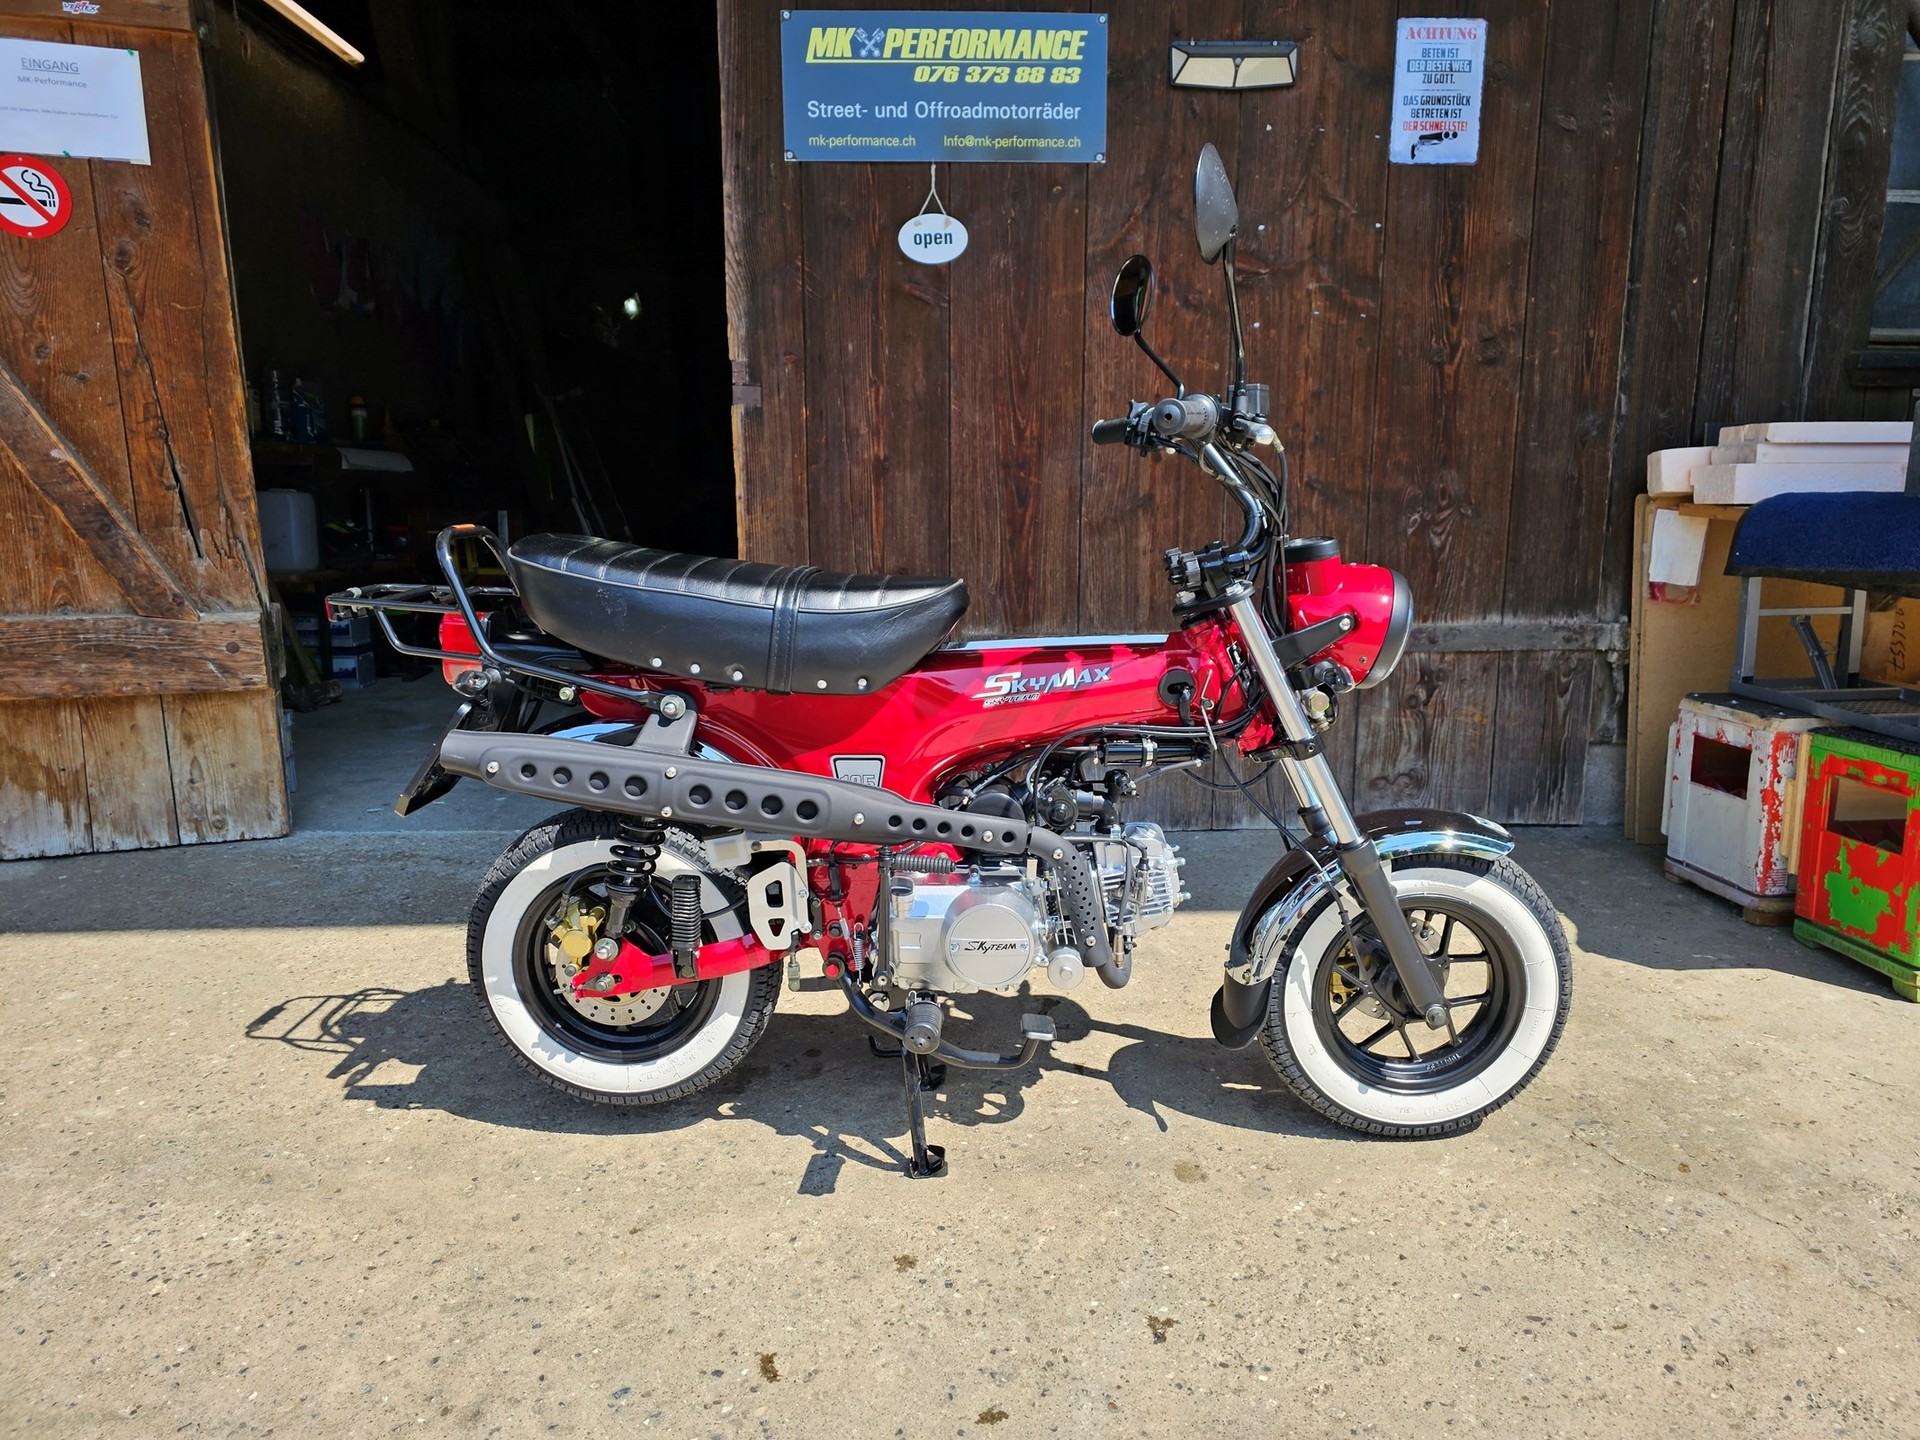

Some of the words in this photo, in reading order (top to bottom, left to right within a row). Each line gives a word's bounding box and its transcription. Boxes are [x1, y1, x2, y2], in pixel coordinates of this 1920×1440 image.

[1405, 26, 1478, 40] ACHTUNG
[806, 27, 856, 63] MK
[882, 28, 1088, 60] PERFORMANCE
[1421, 47, 1446, 59] BETEN
[1447, 47, 1460, 58] IST
[21, 57, 79, 73] EINGANG
[1409, 60, 1426, 72] DER
[1426, 60, 1452, 72] BESTE
[1452, 60, 1470, 72] WEG
[17, 75, 87, 88] MK-Performance
[913, 65, 960, 83] 076
[964, 65, 1011, 84] 373
[1013, 66, 1046, 84] 88
[1049, 66, 1082, 84] 83
[1422, 73, 1433, 84] ZU
[1434, 73, 1456, 84] GOTT.
[1403, 95, 1419, 107] DAS
[1420, 93, 1471, 106] GRUNDSTÜCK
[807, 100, 868, 118] Street-
[874, 101, 908, 118] und
[914, 101, 1081, 120] Offroadmotorräder
[1410, 108, 1449, 118] BETRETEN
[1450, 108, 1462, 118] IST
[1402, 120, 1418, 131] DER
[1419, 120, 1468, 132] SCHNELLSTE!
[808, 134, 916, 148] mk-performance.ch
[943, 135, 1082, 148] Info@mk-performance.ch
[913, 231, 953, 248] open
